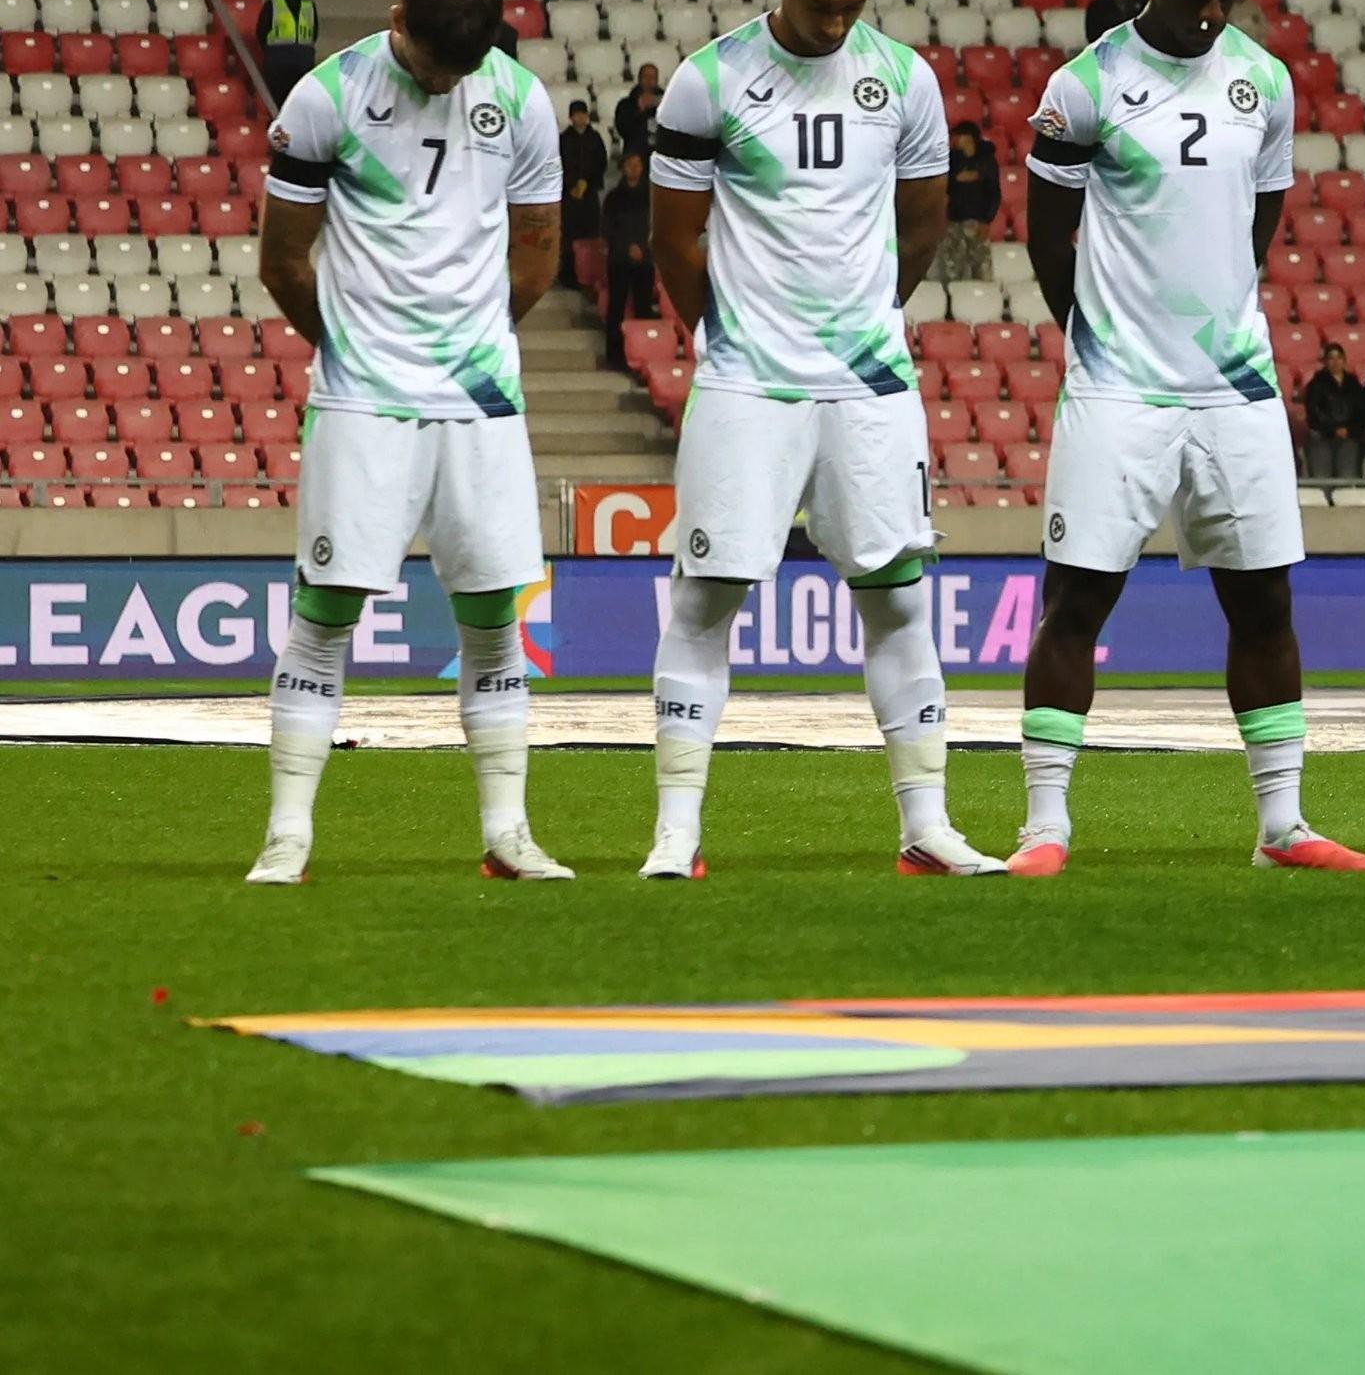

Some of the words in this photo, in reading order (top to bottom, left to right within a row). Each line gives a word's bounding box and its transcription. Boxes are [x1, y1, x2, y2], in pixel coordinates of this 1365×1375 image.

[421, 138, 447, 195] 7
[793, 113, 843, 169] 10
[1180, 112, 1208, 166] 2
[594, 491, 677, 555] C
[0, 582, 411, 666] EAGE
[654, 574, 971, 666] ELCOE
[277, 672, 336, 698] ÉIRE
